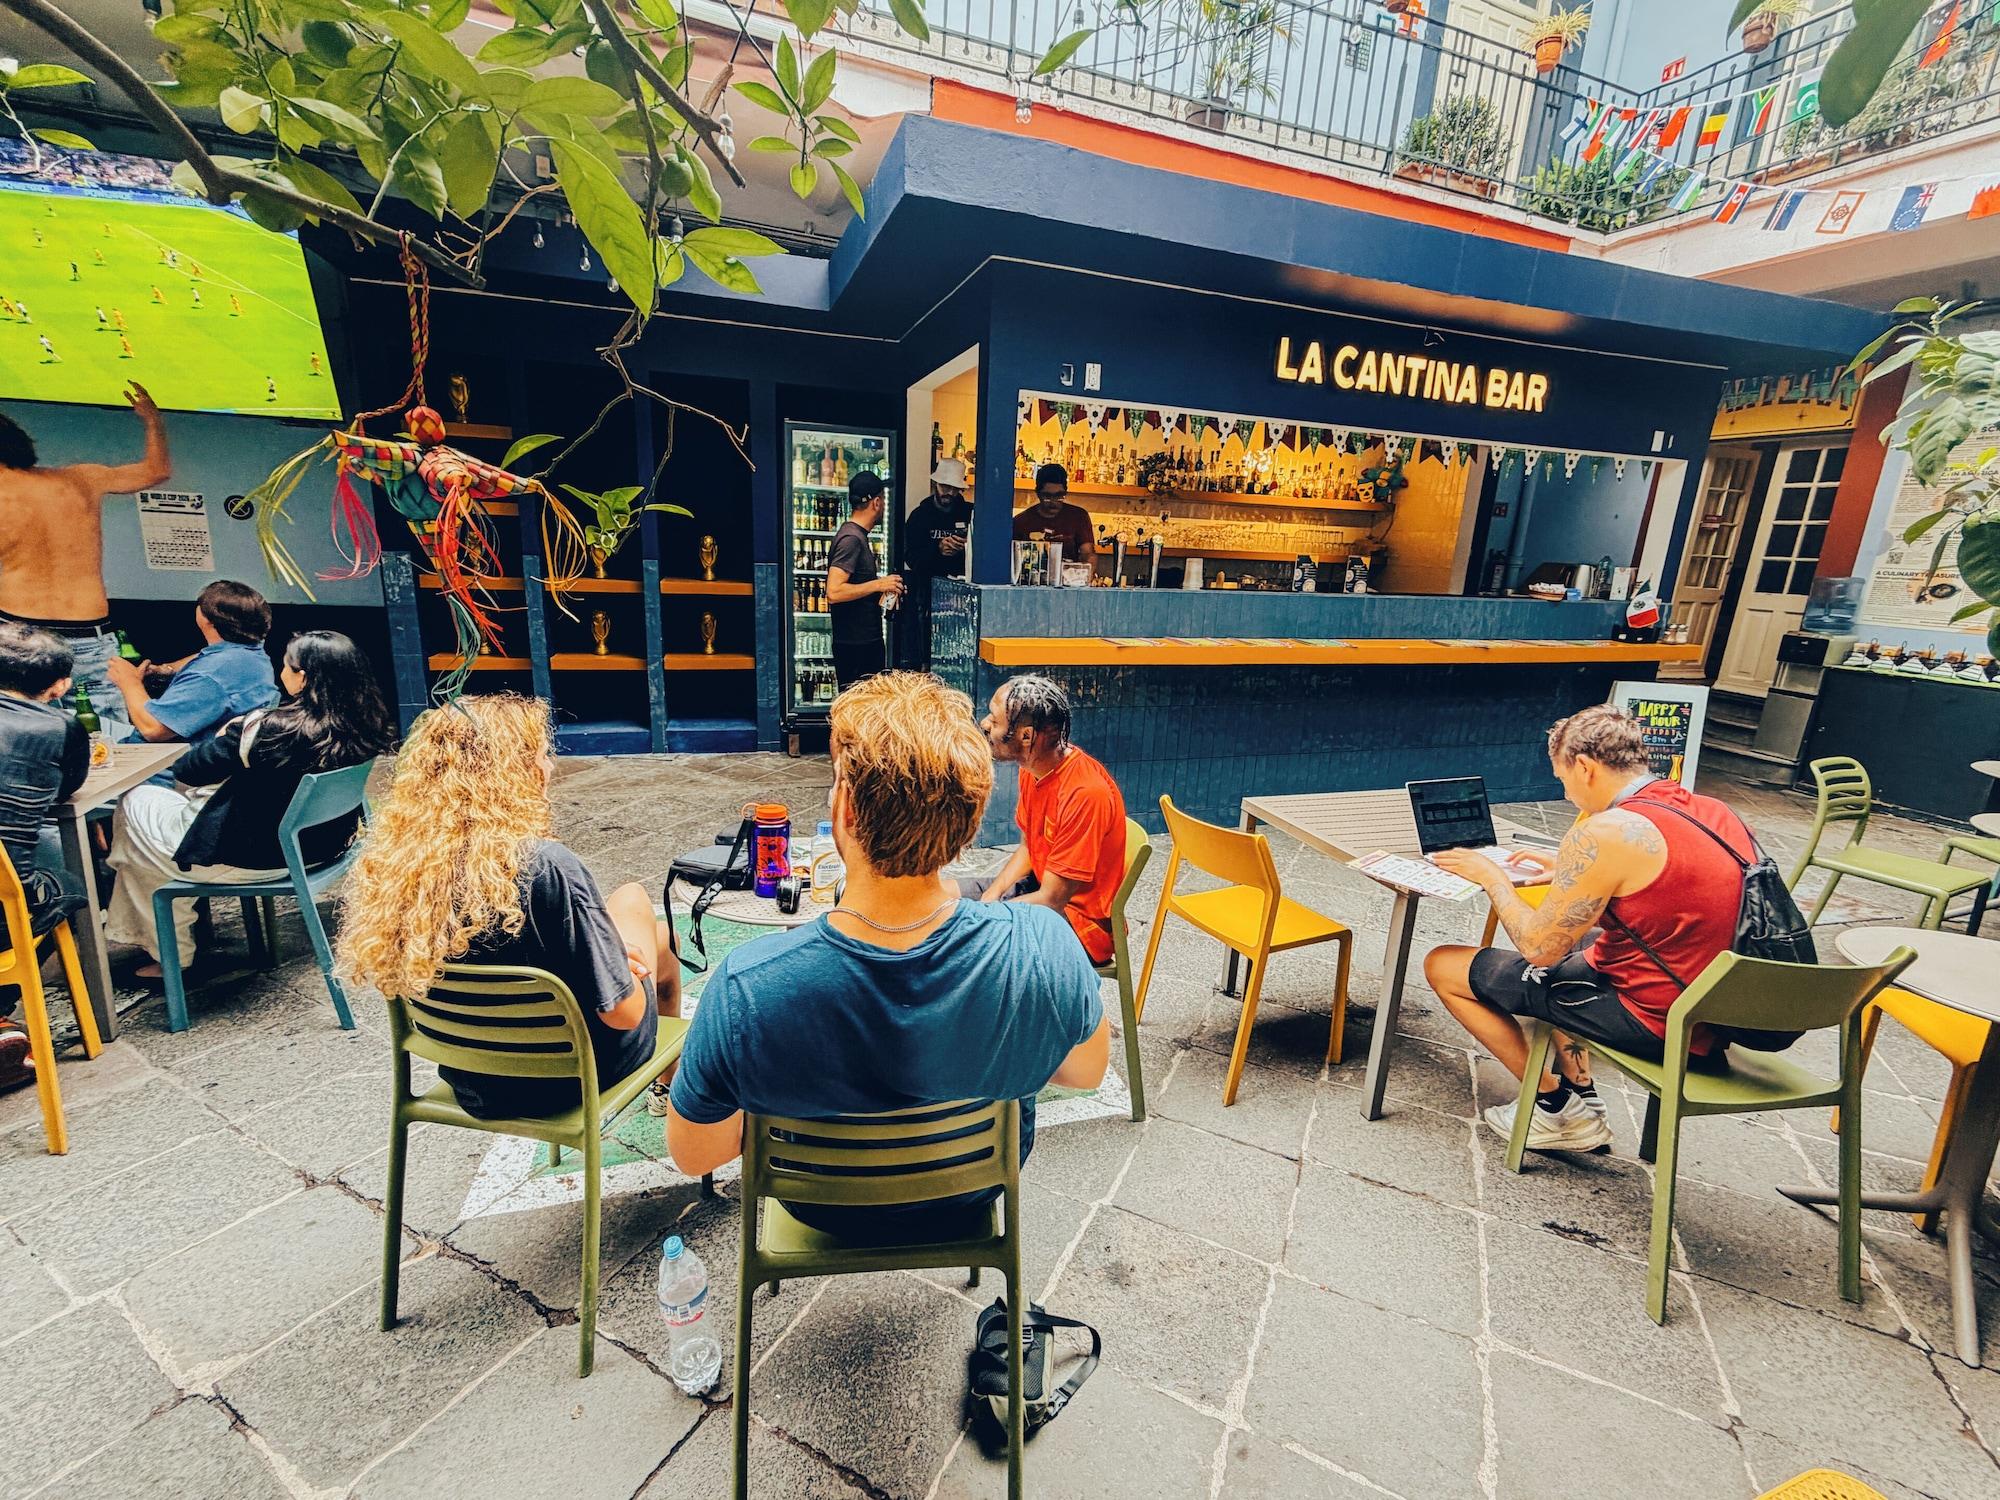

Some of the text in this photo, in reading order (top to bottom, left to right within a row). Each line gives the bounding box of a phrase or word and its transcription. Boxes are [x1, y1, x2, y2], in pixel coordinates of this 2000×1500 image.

[1276, 336, 1548, 413] LA CANTINA BAR
[1639, 701, 1680, 717] HAPPY
[1650, 716, 1681, 727] HOUR
